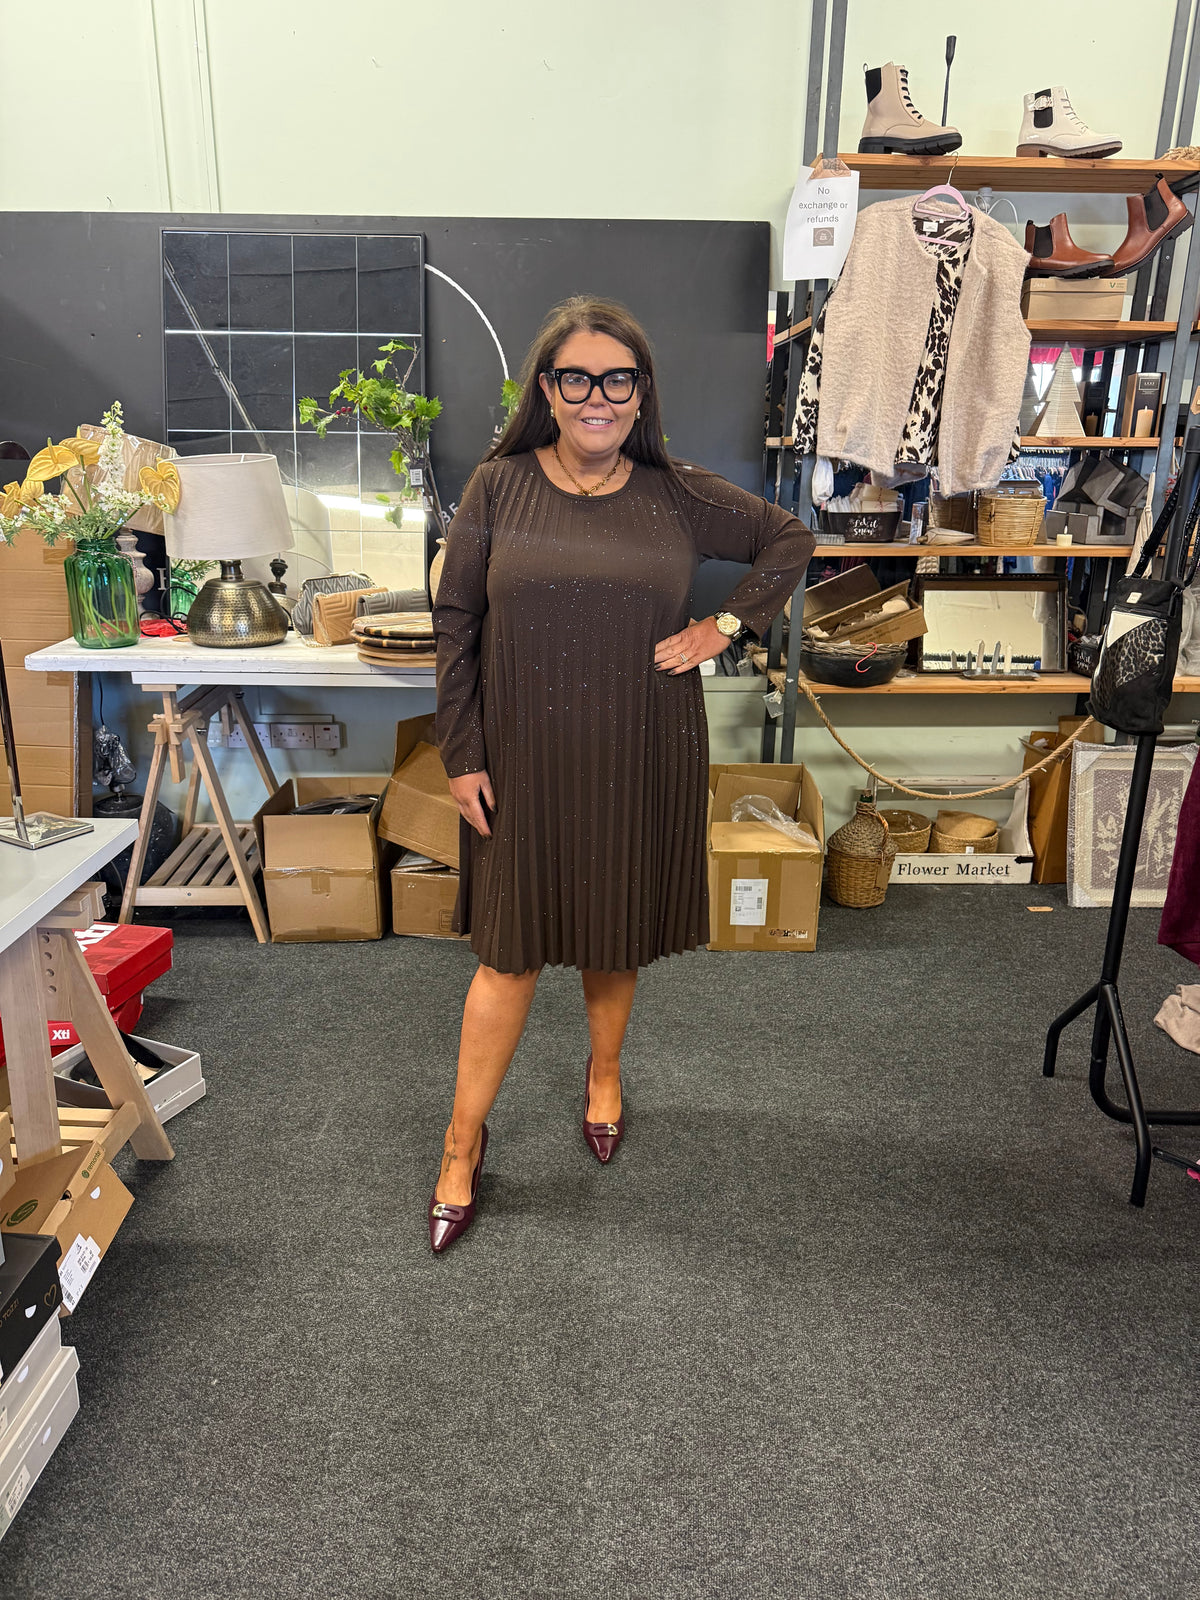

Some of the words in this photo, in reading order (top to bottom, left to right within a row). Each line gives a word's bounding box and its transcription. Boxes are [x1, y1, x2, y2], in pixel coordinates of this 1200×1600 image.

[817, 187, 830, 195] No
[798, 202, 838, 210] exchange
[807, 214, 839, 223] refunds
[897, 863, 949, 876] Flower
[956, 863, 1010, 876] Market
[52, 1029, 71, 1040] Xti
